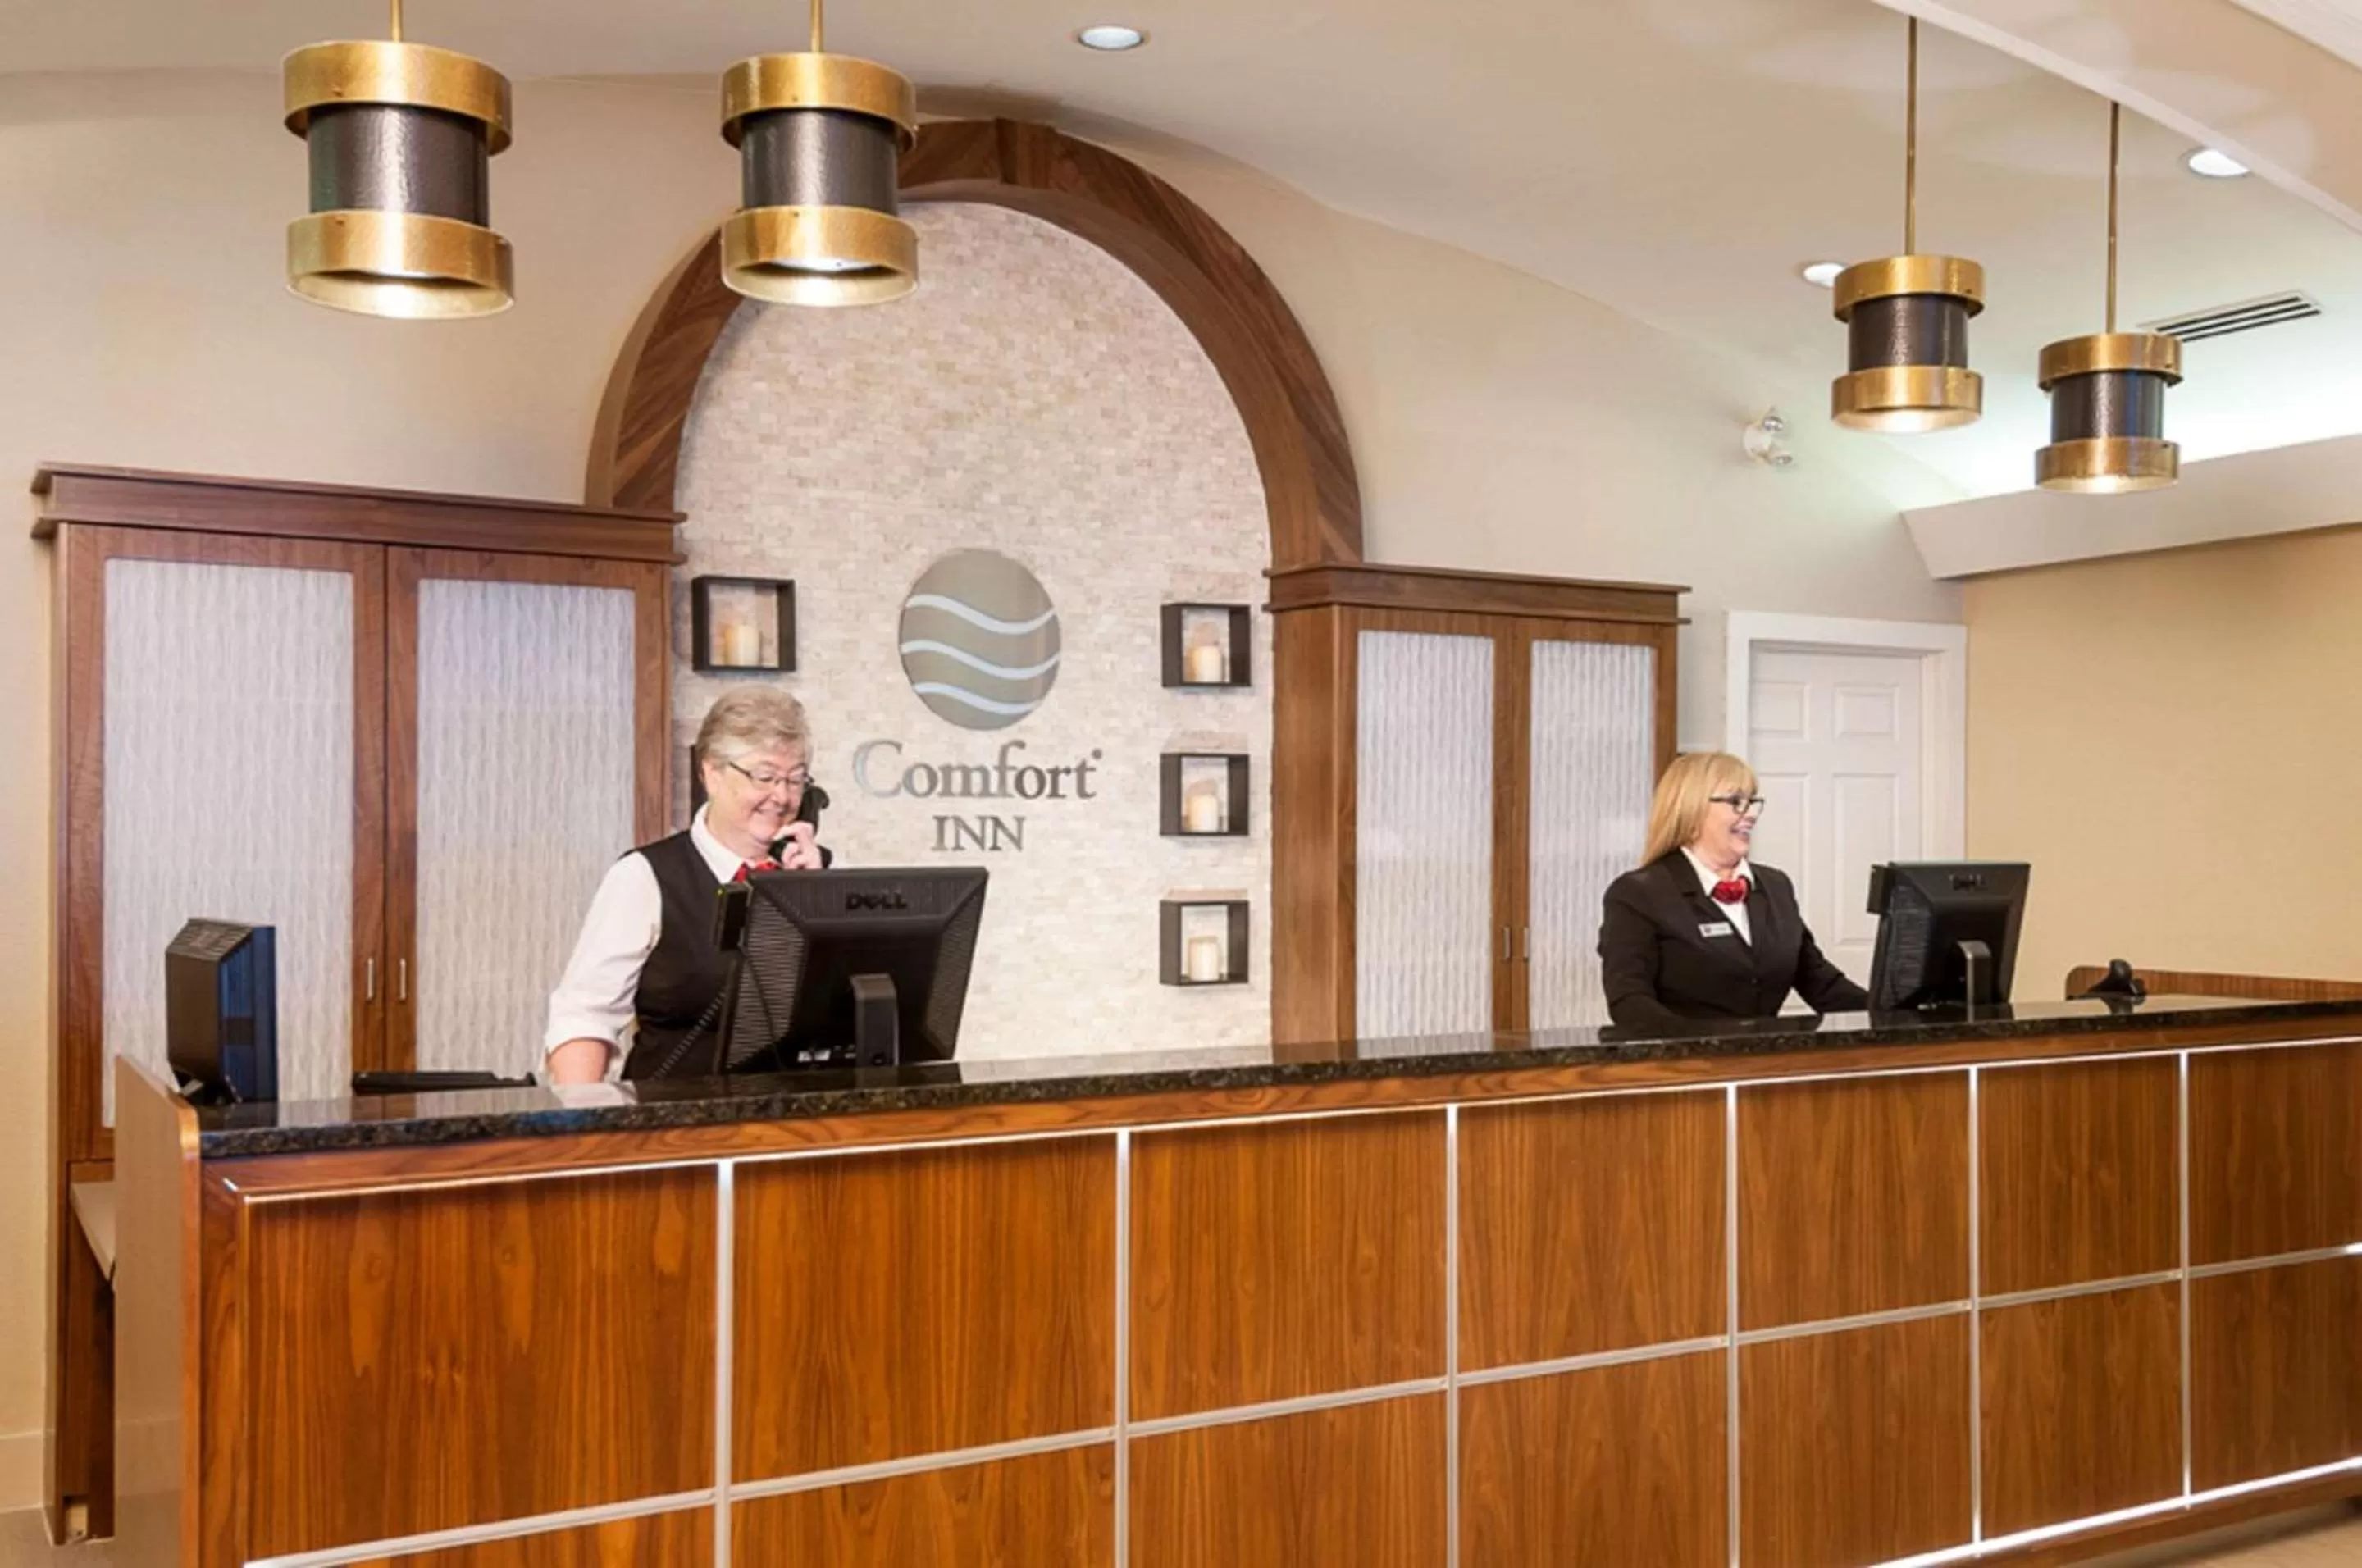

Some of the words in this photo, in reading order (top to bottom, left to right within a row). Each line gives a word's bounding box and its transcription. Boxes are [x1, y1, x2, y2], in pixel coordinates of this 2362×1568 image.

[853, 739, 1097, 799] Comfort
[931, 815, 1026, 851] INN
[846, 893, 907, 910] DELL
